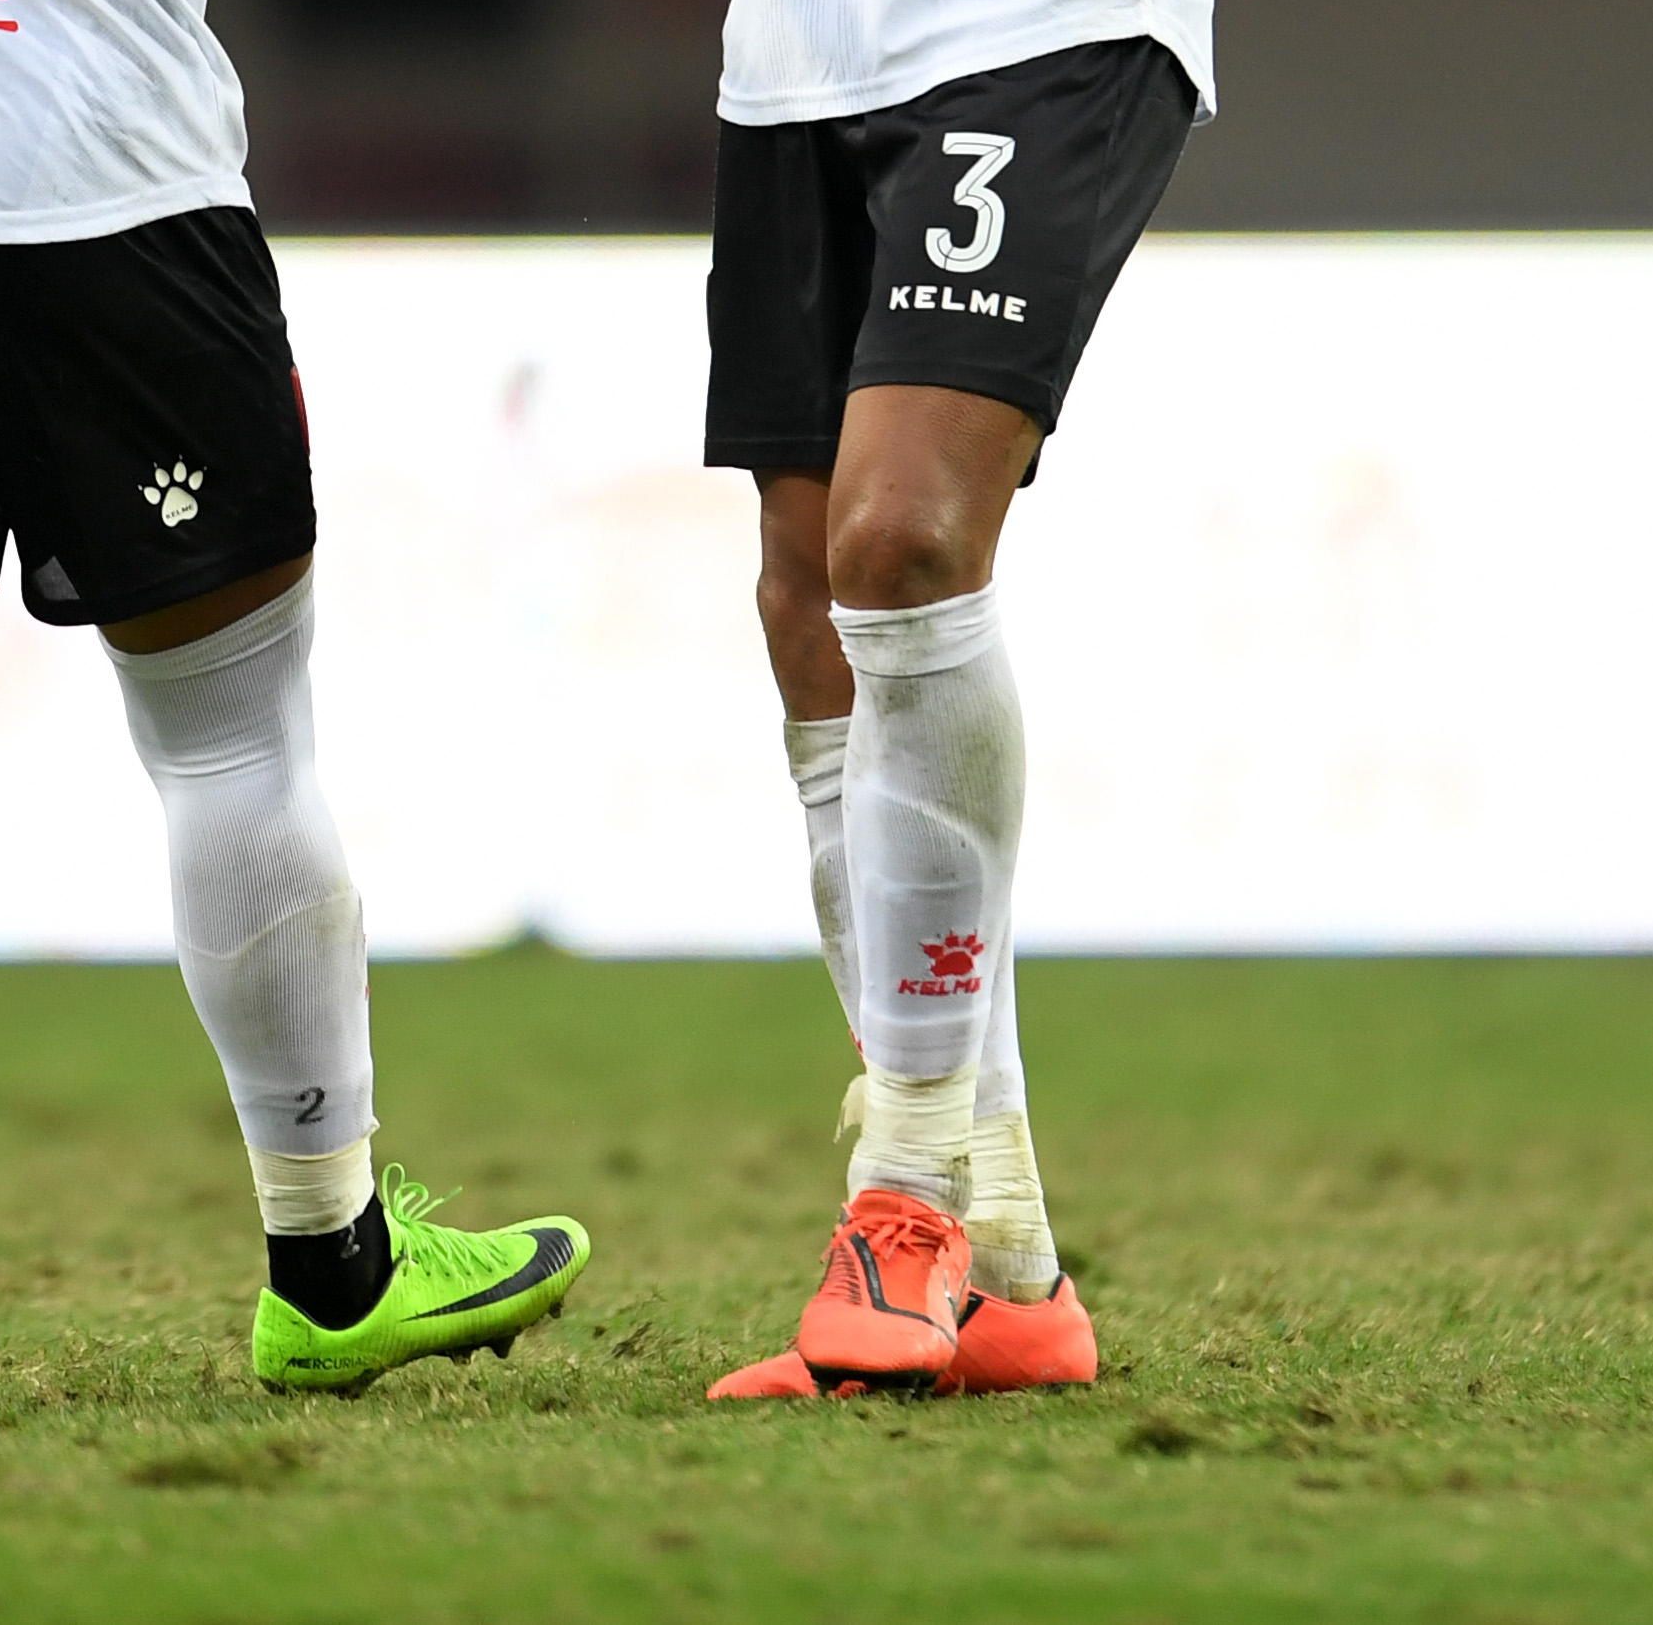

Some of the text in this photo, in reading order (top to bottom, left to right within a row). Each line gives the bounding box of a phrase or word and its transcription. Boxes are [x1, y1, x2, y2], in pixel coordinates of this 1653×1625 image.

[925, 131, 1016, 273] 3
[889, 285, 1027, 322] KELME
[294, 1086, 325, 1126] 2
